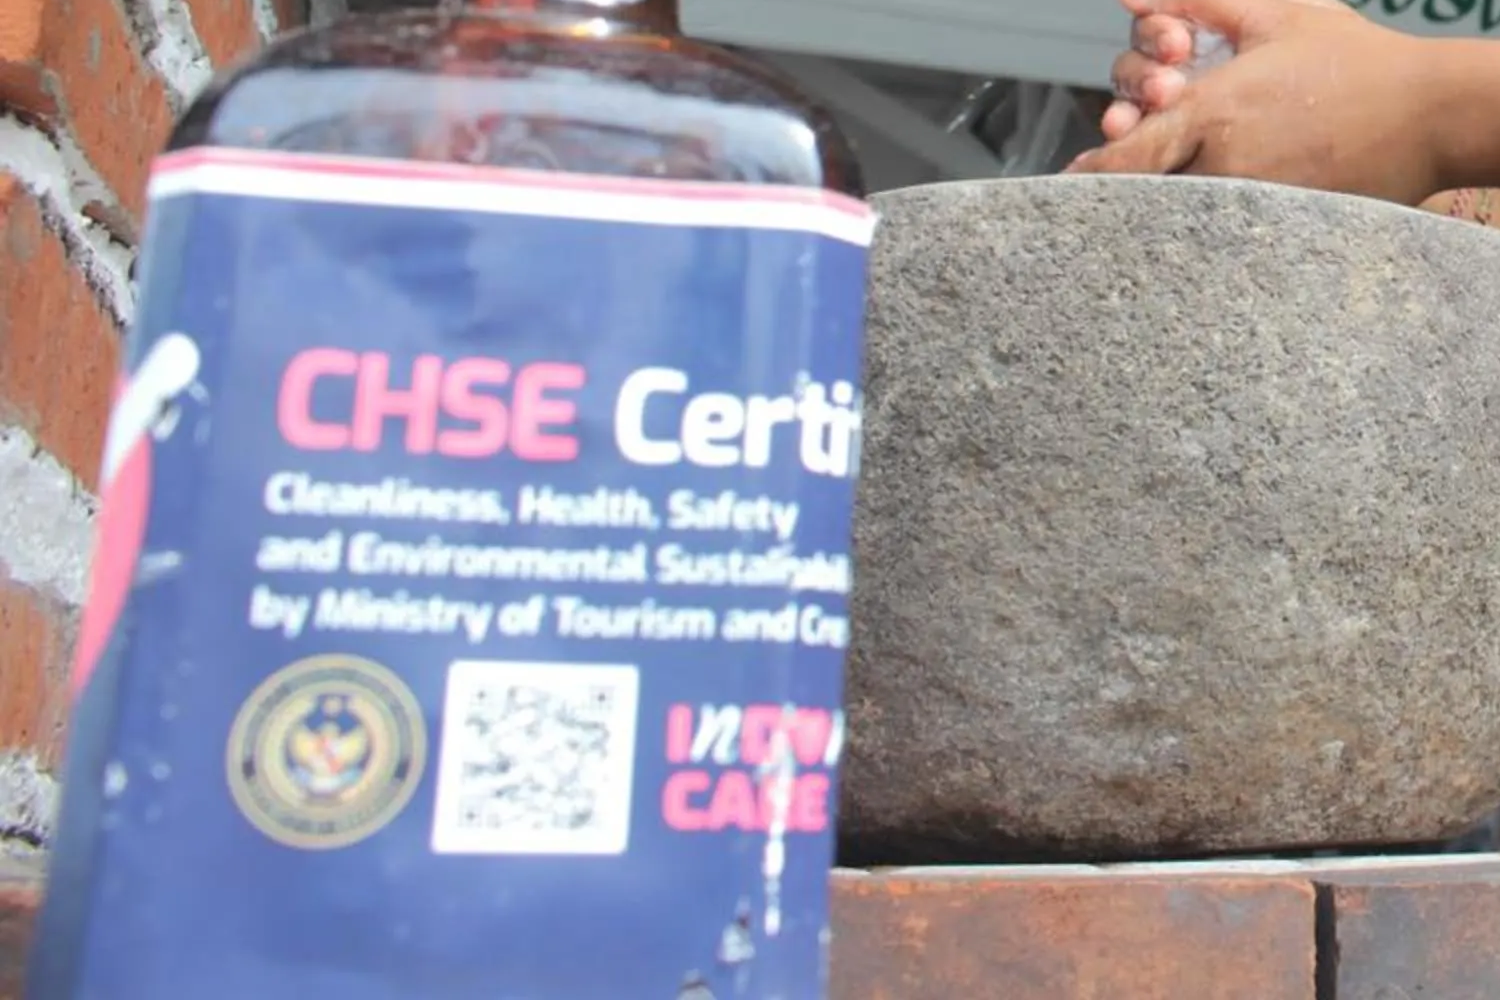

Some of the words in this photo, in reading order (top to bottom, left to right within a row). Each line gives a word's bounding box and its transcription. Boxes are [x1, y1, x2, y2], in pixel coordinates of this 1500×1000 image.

[277, 348, 586, 461] CHSE
[667, 488, 799, 542] Safety
[256, 530, 342, 574] and
[349, 532, 647, 583] Environmental
[249, 585, 310, 640] by
[313, 588, 492, 642] Ministry
[497, 596, 546, 636] of
[551, 596, 716, 642] Tourism
[720, 602, 799, 644] and
